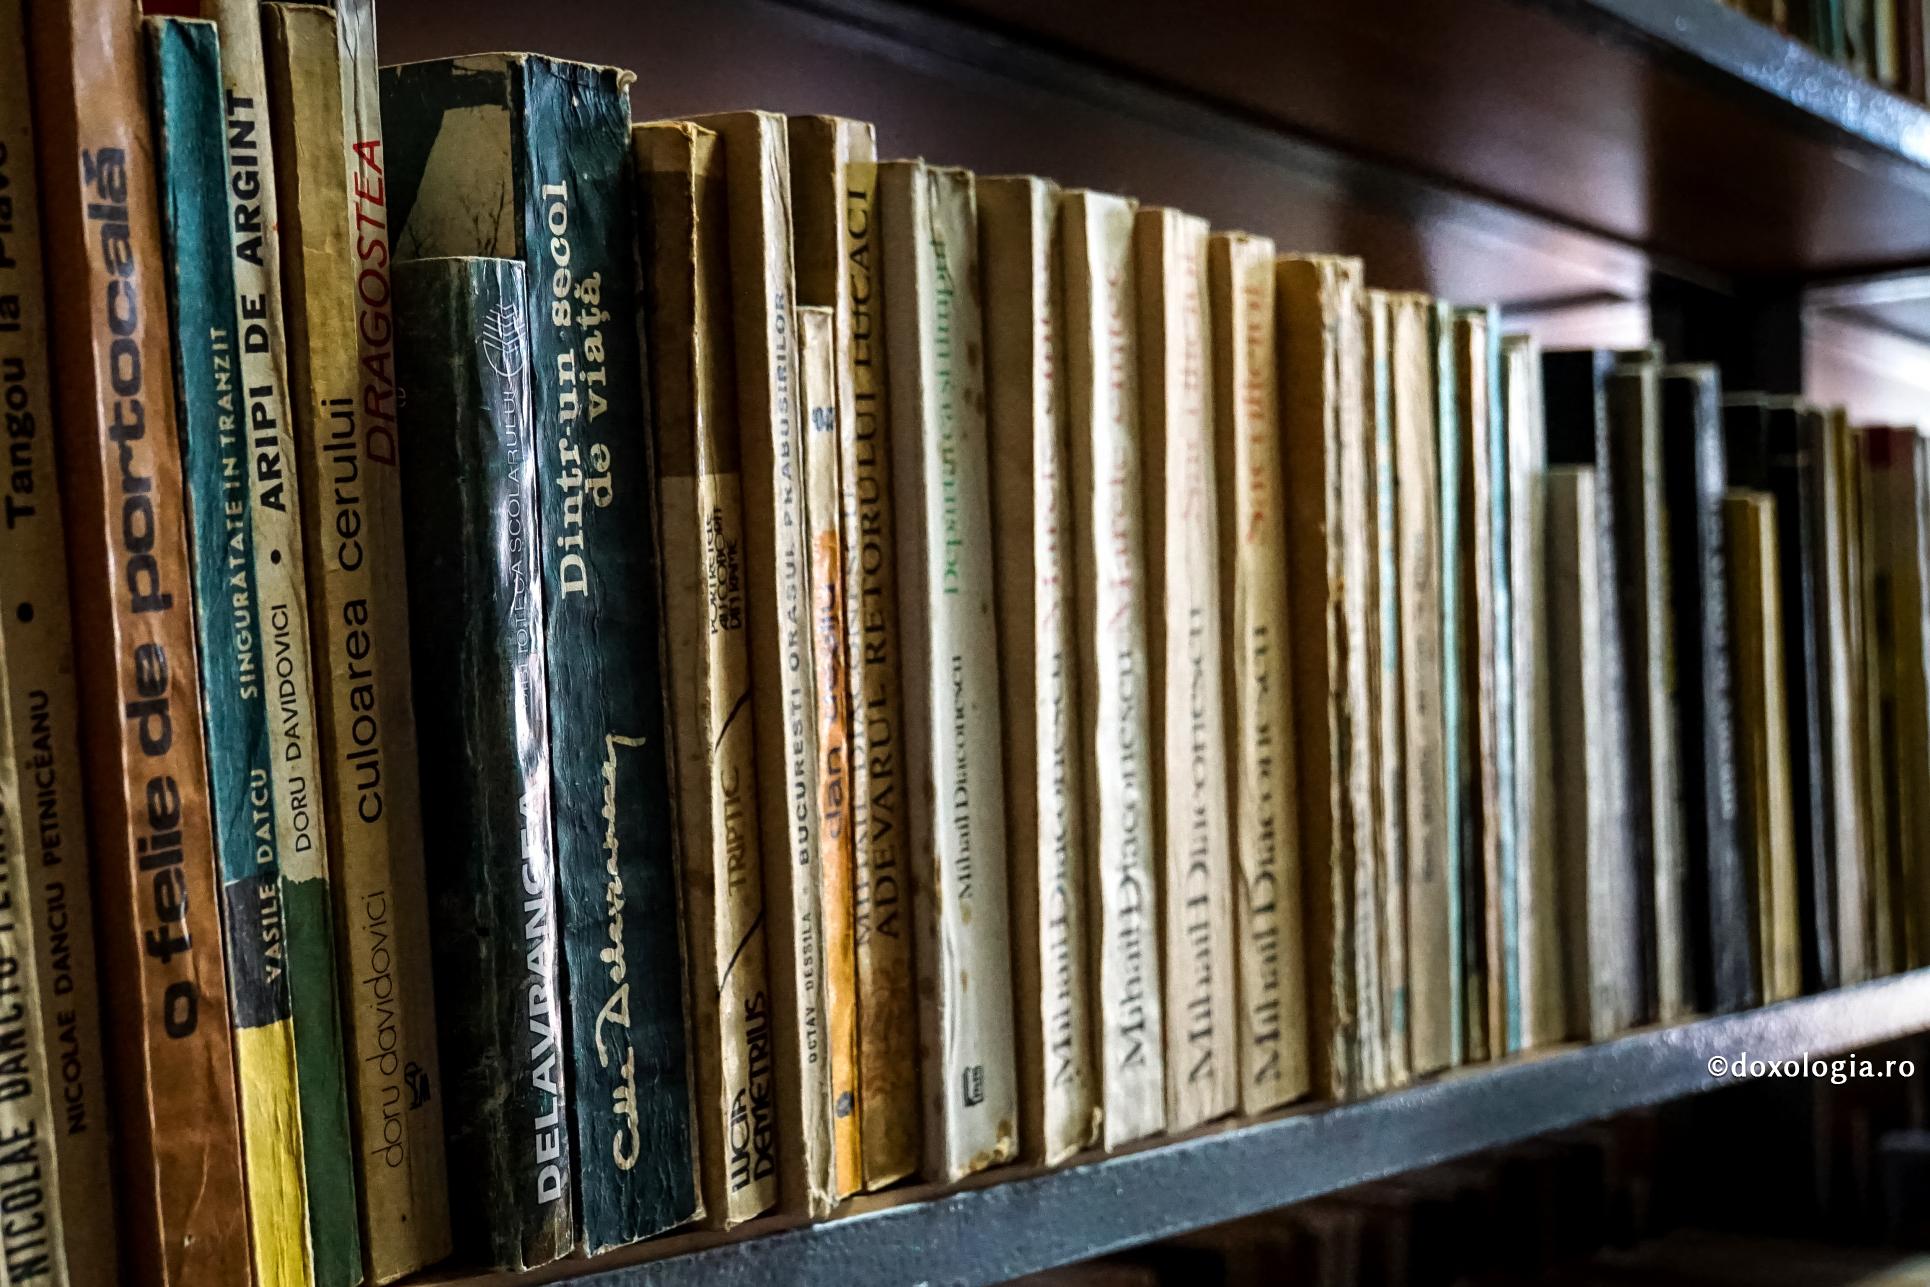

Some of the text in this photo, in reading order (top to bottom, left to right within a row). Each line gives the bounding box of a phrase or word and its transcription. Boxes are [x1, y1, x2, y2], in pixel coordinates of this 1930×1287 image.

[0, 293, 21, 333] la
[352, 138, 396, 466] DRAGOSTEA
[845, 186, 874, 368] LUCACI
[3, 357, 35, 529] Tangou
[209, 325, 237, 449] TRANZIT
[542, 179, 588, 598] Dintr-un secol
[226, 88, 313, 853] DORU DAVIDOVICI ARIPI DE ARGINT
[585, 441, 614, 508] de
[853, 391, 890, 666] RETORULUI
[82, 146, 199, 1039] o felie de portocală
[321, 396, 383, 824] culoarea cerului
[250, 768, 274, 865] DATCU
[720, 766, 747, 897] TRIPTIC
[949, 655, 973, 899] Mihail Diaconescu
[45, 882, 74, 994] DANCIU
[257, 883, 284, 985] VASILE
[800, 911, 815, 991] DESSILA
[1115, 927, 1148, 1068] Mihail
[1184, 918, 1216, 1082] Mihail
[1252, 926, 1282, 1083] Mihail
[54, 1010, 88, 1135] NICOLAE
[360, 890, 406, 1169] doru davidovici
[744, 991, 775, 1182] DEMETRIUS
[804, 1005, 818, 1064] OCTAV
[0, 1121, 50, 1284] NICOLAE
[730, 1088, 750, 1193] LUCIA
